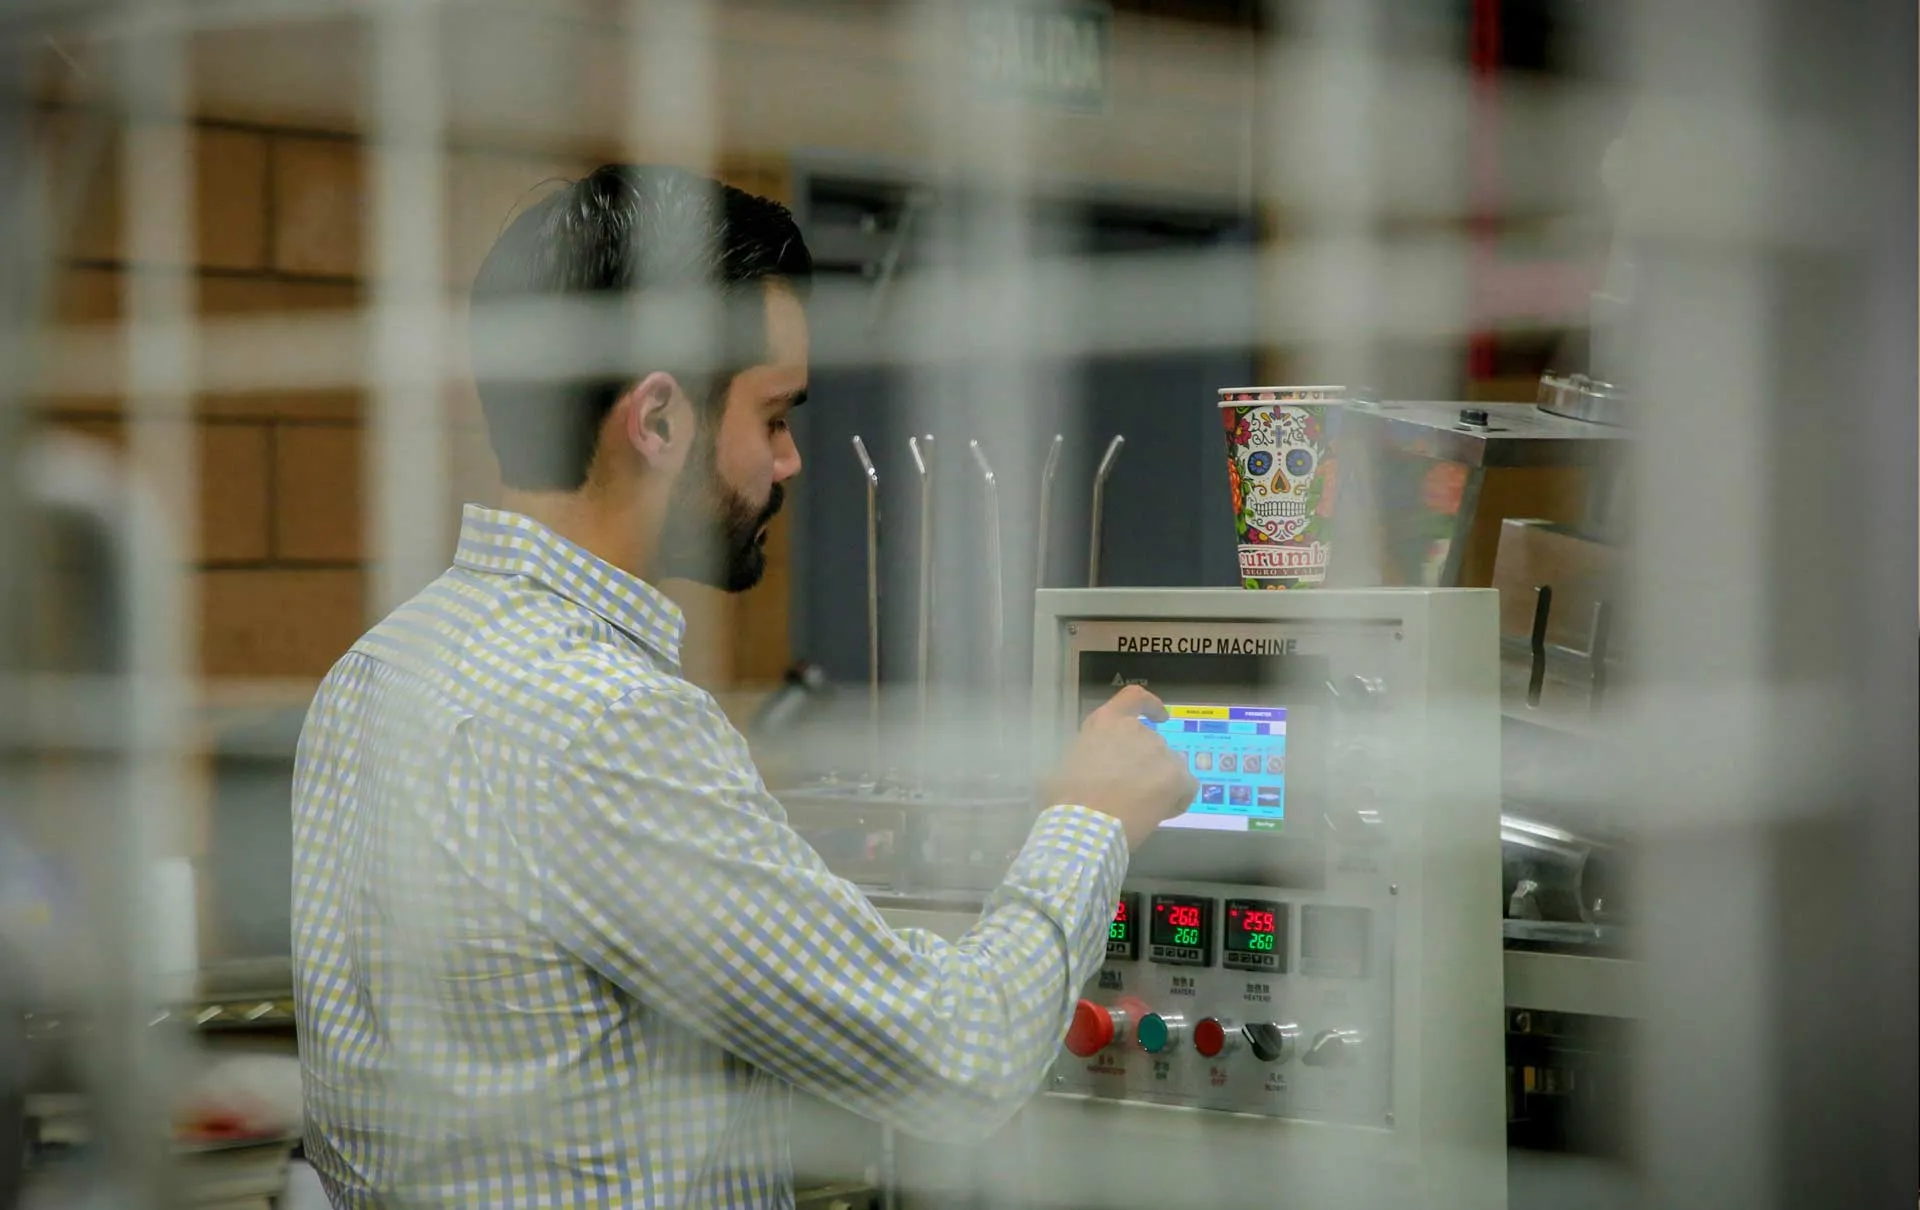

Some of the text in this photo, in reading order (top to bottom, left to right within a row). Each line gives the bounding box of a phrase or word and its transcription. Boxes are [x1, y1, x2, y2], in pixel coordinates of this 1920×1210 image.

[1118, 636, 1298, 656] PAPER CUP MACHINE
[1174, 927, 1199, 945] 260
[1249, 933, 1274, 950] 260
